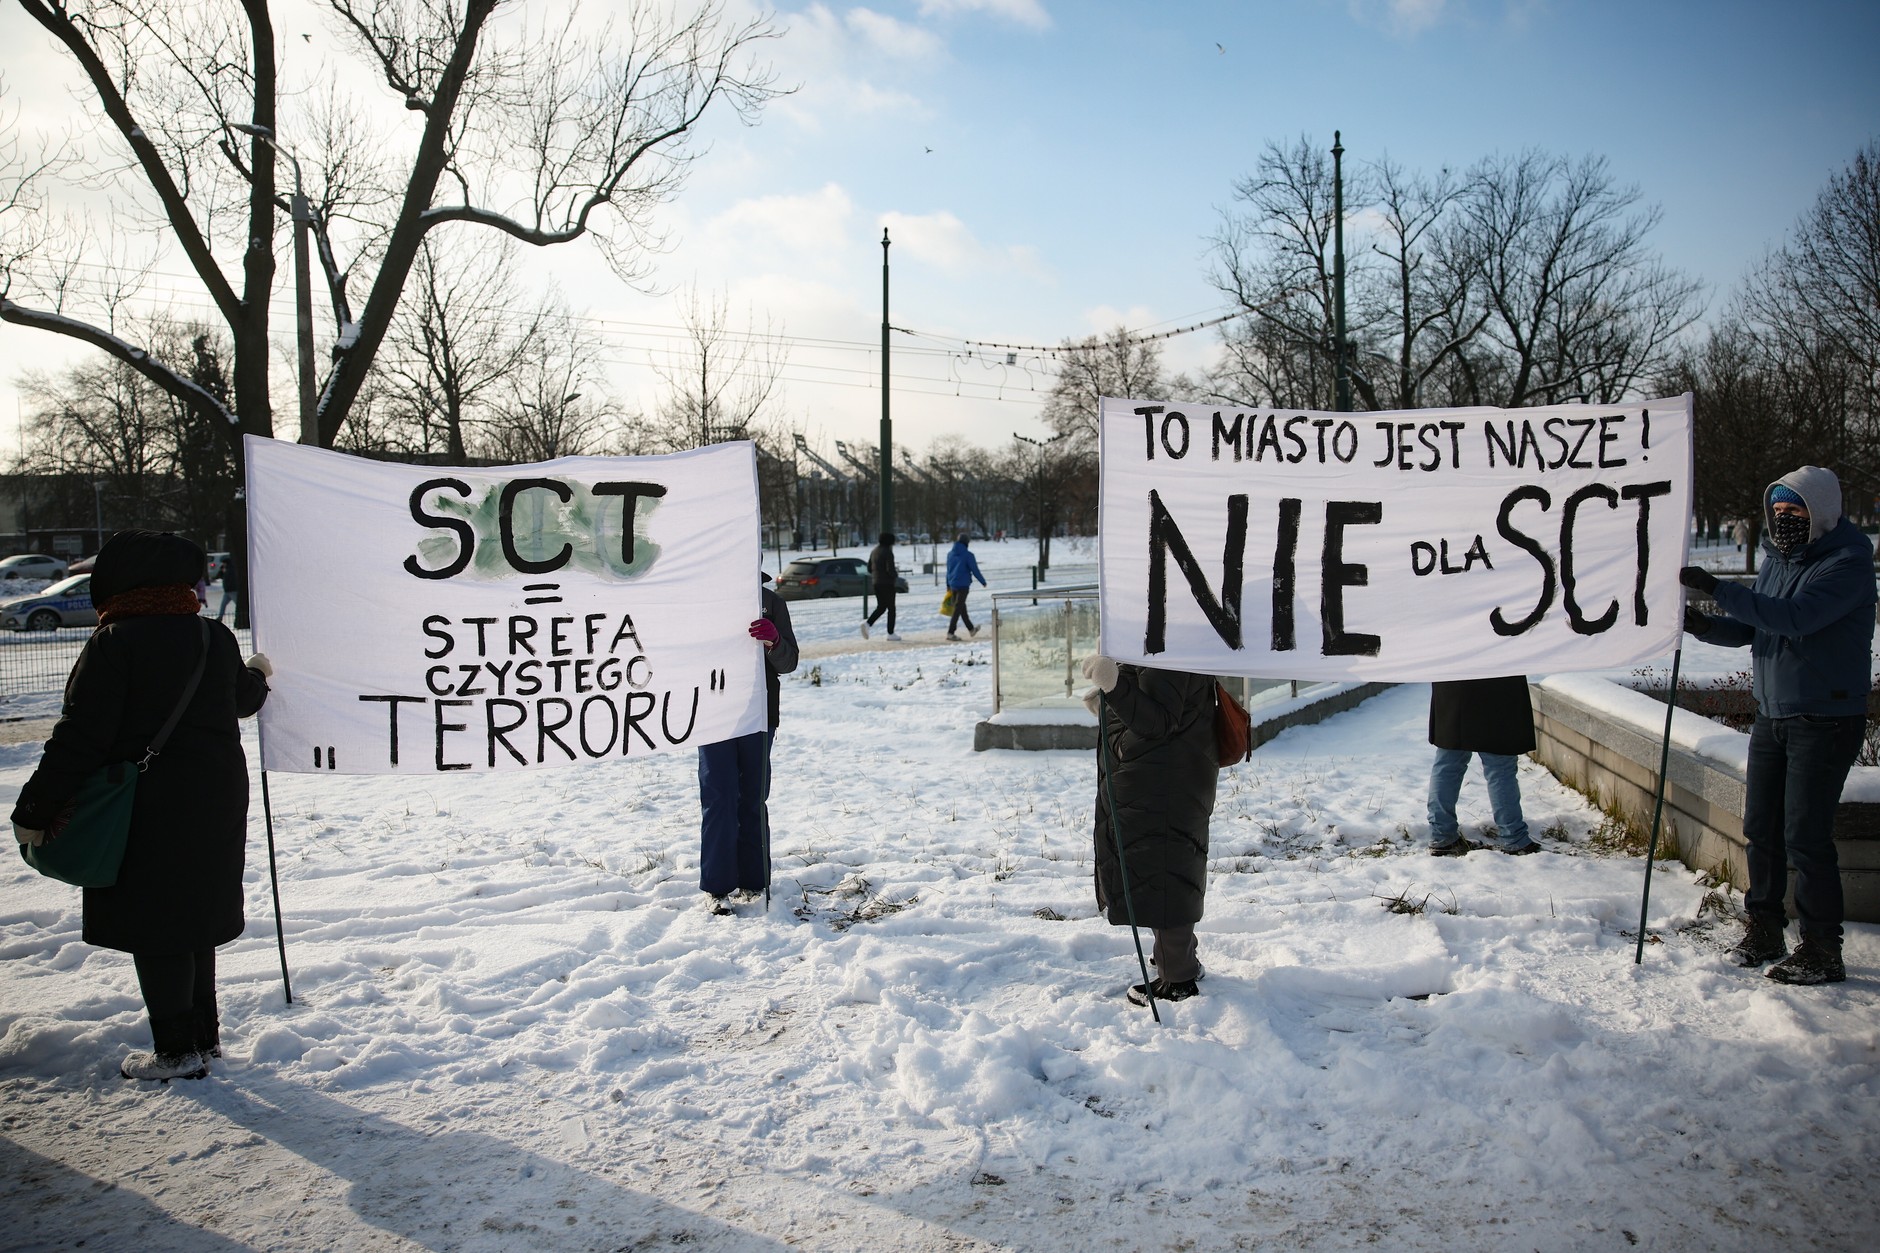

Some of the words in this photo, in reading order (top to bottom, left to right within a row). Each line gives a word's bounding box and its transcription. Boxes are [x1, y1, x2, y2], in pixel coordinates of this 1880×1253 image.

[1134, 405, 1190, 461] TO
[1211, 410, 1358, 464] MIASTO
[1373, 420, 1466, 472] JEST
[403, 477, 668, 580] SCT
[1143, 488, 1383, 657] NIE
[1410, 534, 1494, 577] DLA
[1489, 479, 1672, 637] SCT
[67, 600, 93, 610] POLIC
[422, 613, 645, 659] STREFA
[425, 655, 654, 696] CZYSTEGO
